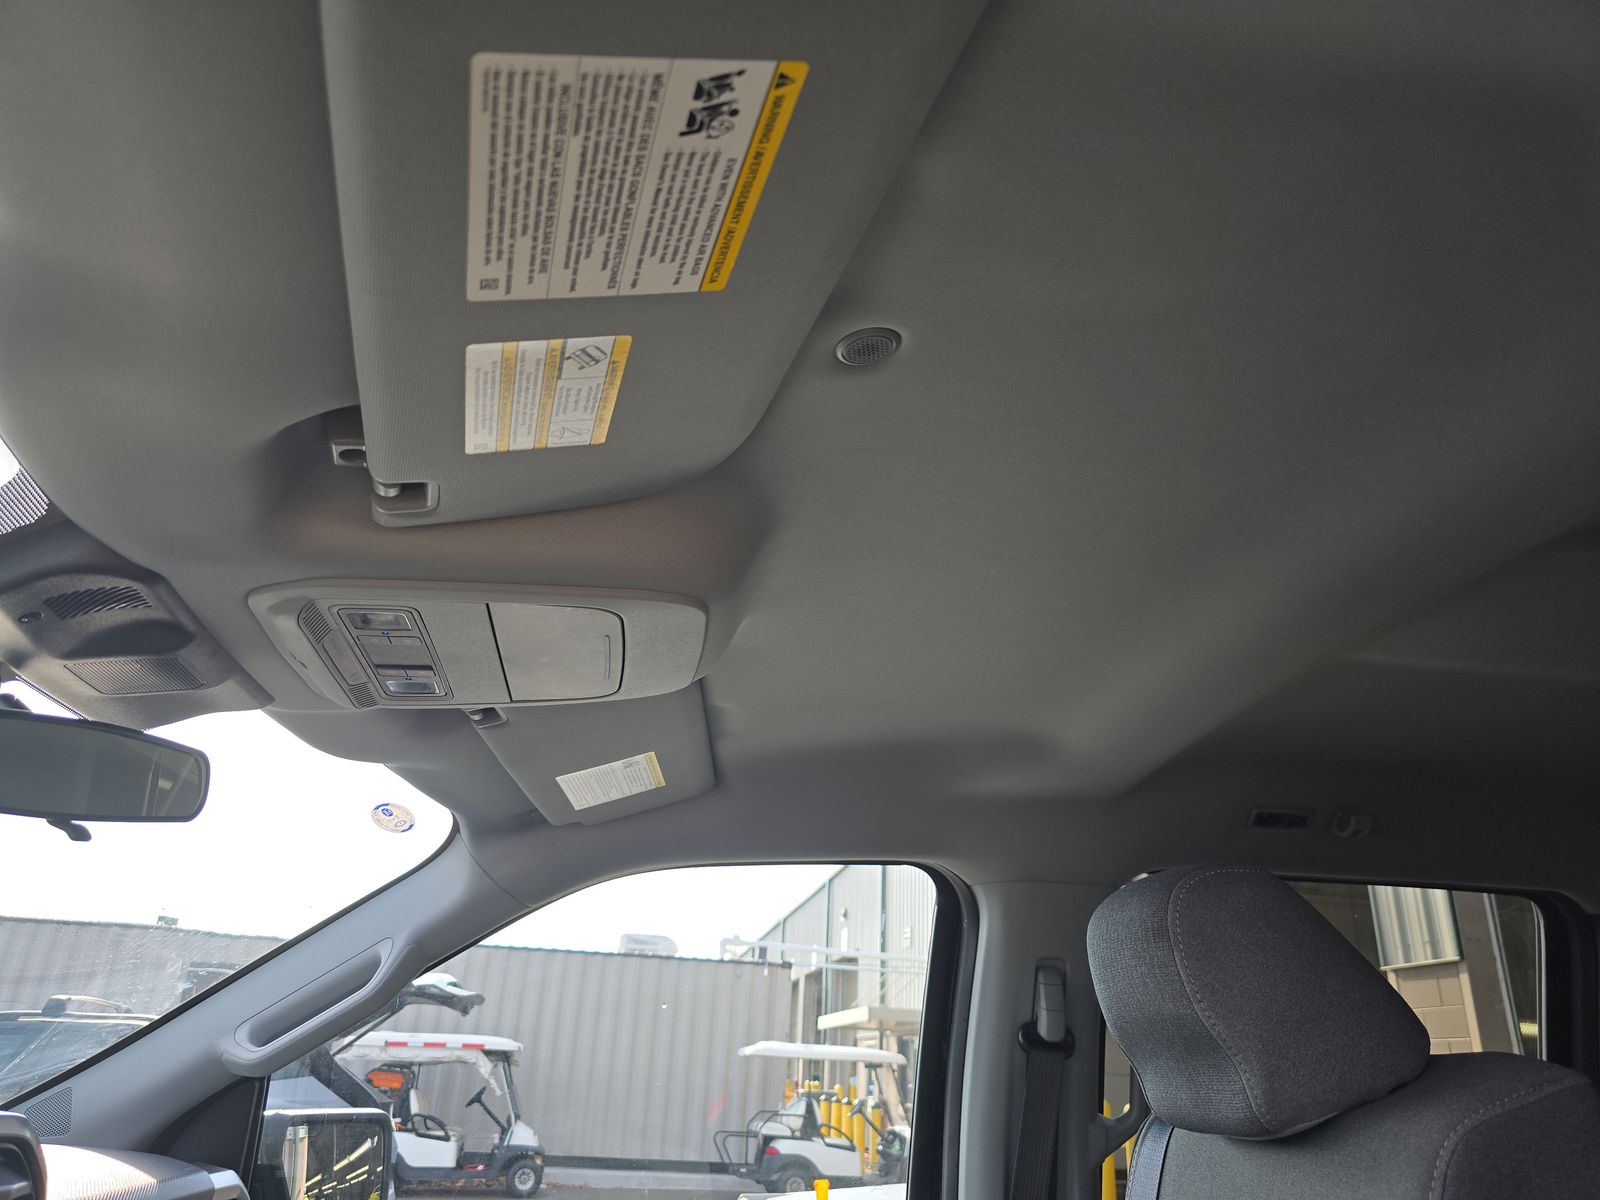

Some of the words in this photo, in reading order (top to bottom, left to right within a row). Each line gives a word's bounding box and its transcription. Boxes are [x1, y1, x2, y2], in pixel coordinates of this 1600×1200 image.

[756, 94, 786, 144] WARNING
[719, 157, 737, 181] EVEN
[699, 202, 722, 243] ADVANCED
